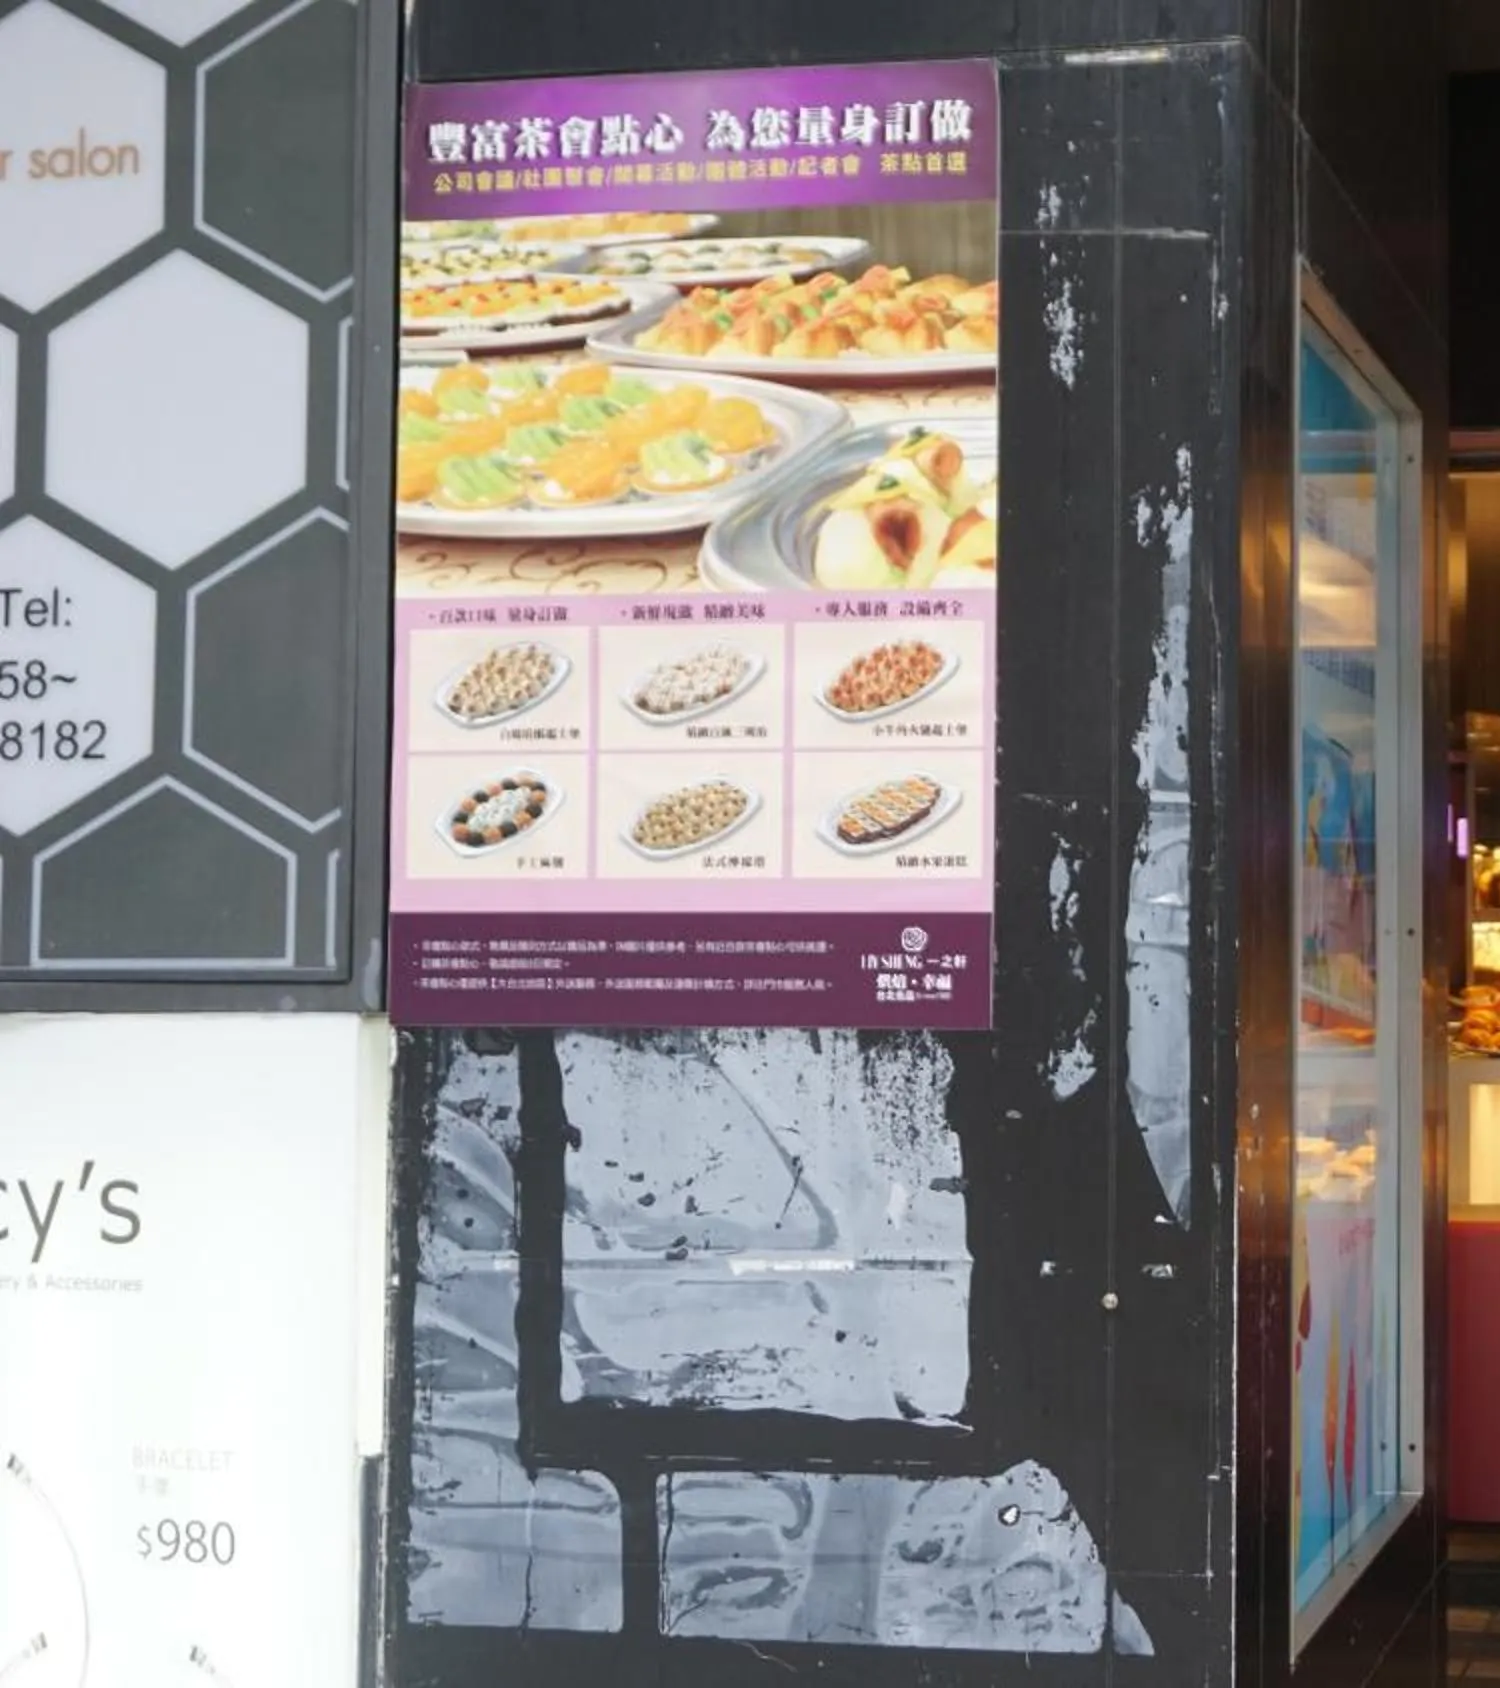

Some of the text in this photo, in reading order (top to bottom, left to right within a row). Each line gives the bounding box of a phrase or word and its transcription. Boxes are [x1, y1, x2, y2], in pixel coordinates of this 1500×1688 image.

[428, 99, 972, 163] 豐富茶會點心 為您量身訂做
[28, 126, 140, 179] salon
[880, 151, 967, 175] 茶點首選
[0, 586, 72, 628] Tel:
[0, 659, 77, 700] 58~
[0, 720, 107, 761] 8182
[0, 1159, 141, 1264] y's
[132, 1445, 237, 1473] BRACELET
[136, 1518, 236, 1566] $980
